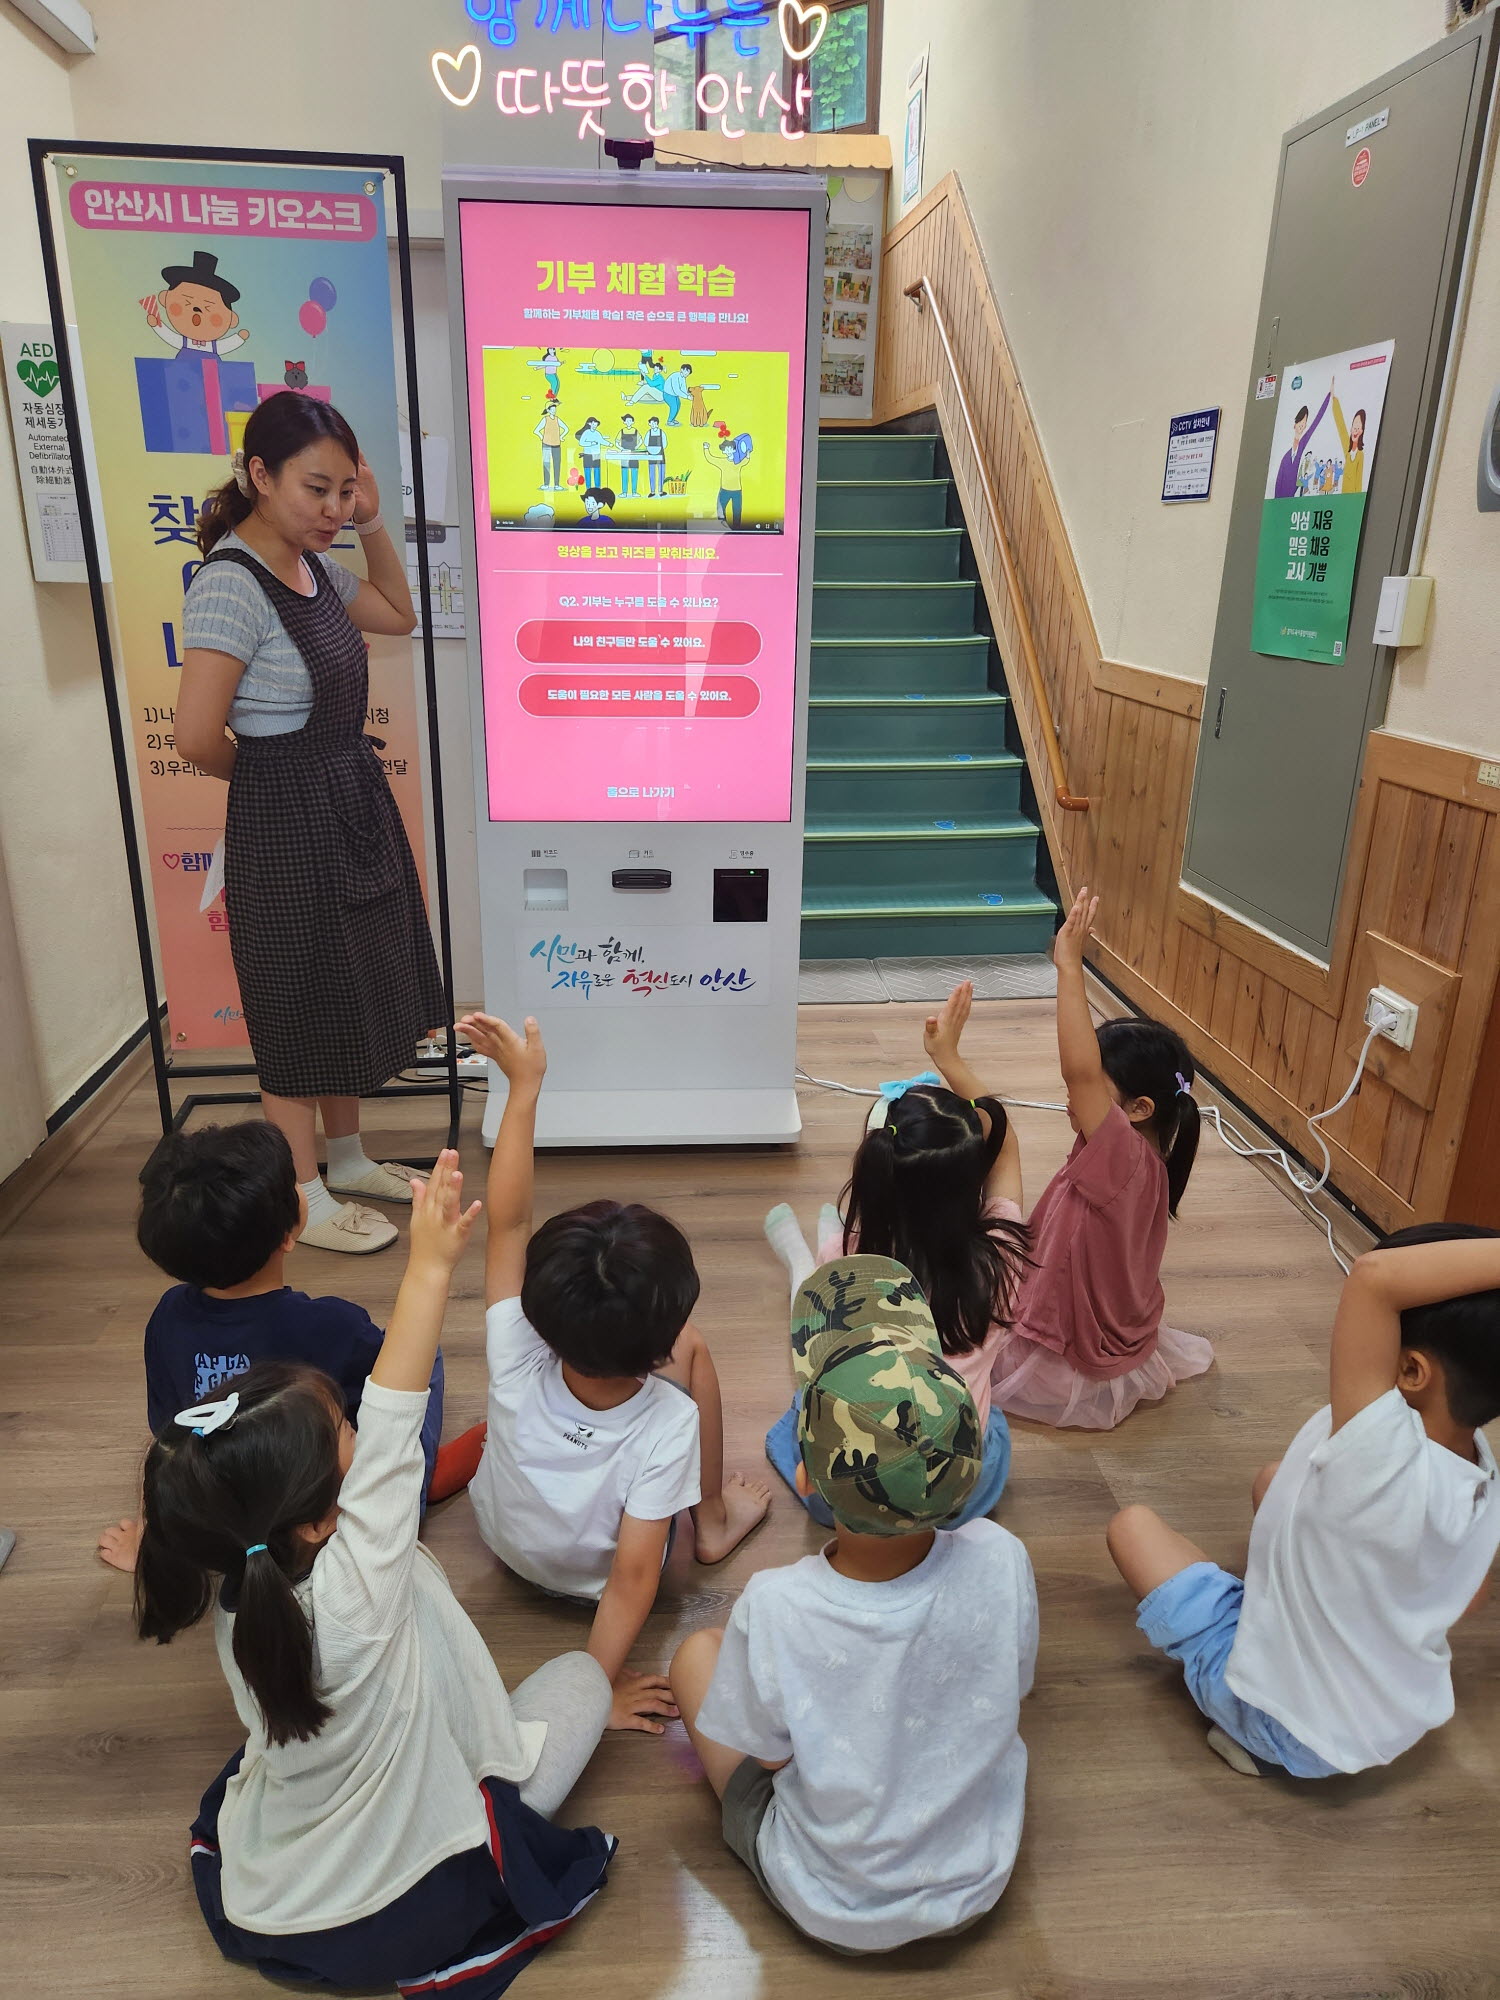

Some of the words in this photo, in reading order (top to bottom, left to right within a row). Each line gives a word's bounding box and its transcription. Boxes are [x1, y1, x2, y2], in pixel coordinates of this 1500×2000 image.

[496, 59, 678, 139] 따뜻한
[696, 71, 814, 140] 안산
[1364, 117, 1381, 132] PANEL
[84, 189, 173, 223] 안산시
[181, 193, 239, 226] 나눔
[248, 196, 362, 232] 키오스크
[537, 260, 596, 294] 기부
[606, 261, 666, 296] 체험
[676, 263, 736, 297] 학습
[523, 308, 561, 320] 함께하는
[563, 309, 600, 321] 기부체험
[602, 309, 624, 321] 학습!
[626, 310, 644, 321] 작은
[718, 312, 749, 324] 만나요!
[20, 343, 54, 357] AED
[1178, 421, 1192, 431] CCTV
[33, 443, 66, 451] External
[1290, 511, 1310, 531] 의심
[1312, 510, 1333, 531] 지움
[557, 545, 592, 559] 영상을
[595, 546, 618, 559] 보고
[622, 546, 656, 559] 퀴즈를
[659, 547, 720, 560] 맞춰보세요.
[1289, 536, 1307, 557] 믿음
[1309, 536, 1330, 557] 채움
[1285, 562, 1306, 581] 교사
[1306, 562, 1328, 583] 기쁨
[559, 595, 580, 607] Q2.
[582, 596, 612, 607] 기부는
[614, 596, 644, 607] 누구를
[647, 596, 667, 608] 도울
[669, 597, 680, 607] 수
[682, 597, 719, 608] 있나요?
[573, 636, 593, 647] 나의
[596, 636, 635, 647] 친구들만
[638, 636, 658, 647] 도울
[660, 637, 671, 648] 수
[673, 637, 706, 648] 있어요.
[547, 689, 577, 700] 도움이
[579, 689, 609, 700] 필요한
[611, 690, 631, 700] 모든
[634, 690, 663, 701] 사람을
[665, 690, 685, 701] 도울
[687, 690, 698, 701] 수
[700, 690, 732, 701] 있어요.
[607, 786, 640, 798] 홈으로
[642, 786, 675, 798] 나가기
[530, 934, 597, 972] 시민과
[551, 970, 616, 1001] 자유로운
[623, 968, 692, 998] 혁신도시
[699, 967, 757, 992] 안산
[562, 1432, 589, 1451] PEANUTS
